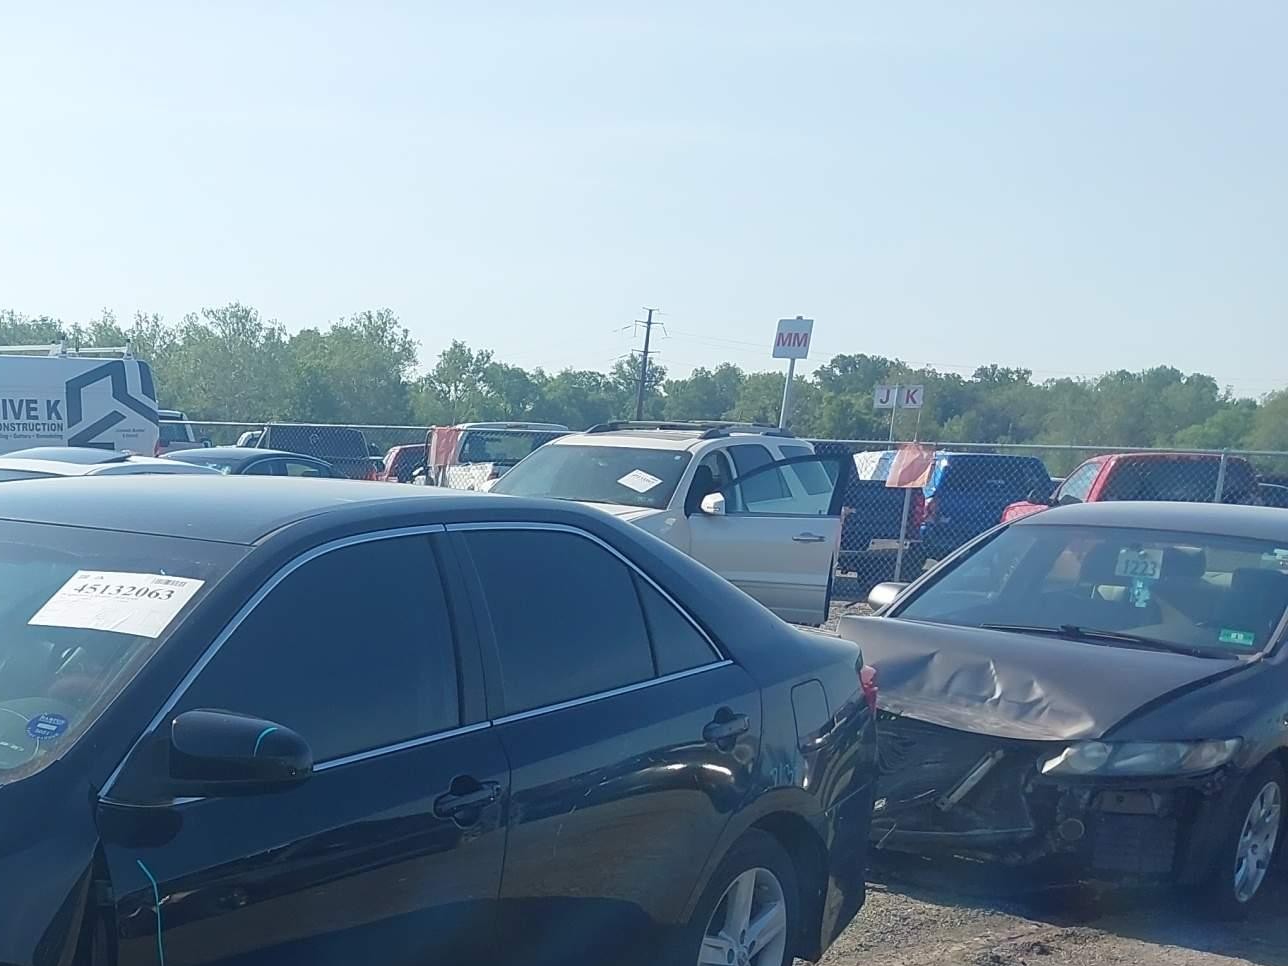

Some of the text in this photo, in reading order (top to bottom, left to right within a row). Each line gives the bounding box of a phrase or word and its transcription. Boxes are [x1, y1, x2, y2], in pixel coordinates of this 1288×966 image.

[776, 332, 809, 347] MM
[879, 390, 890, 405] J
[905, 389, 918, 405] K
[46, 399, 63, 421] K
[73, 583, 175, 601] 45132063
